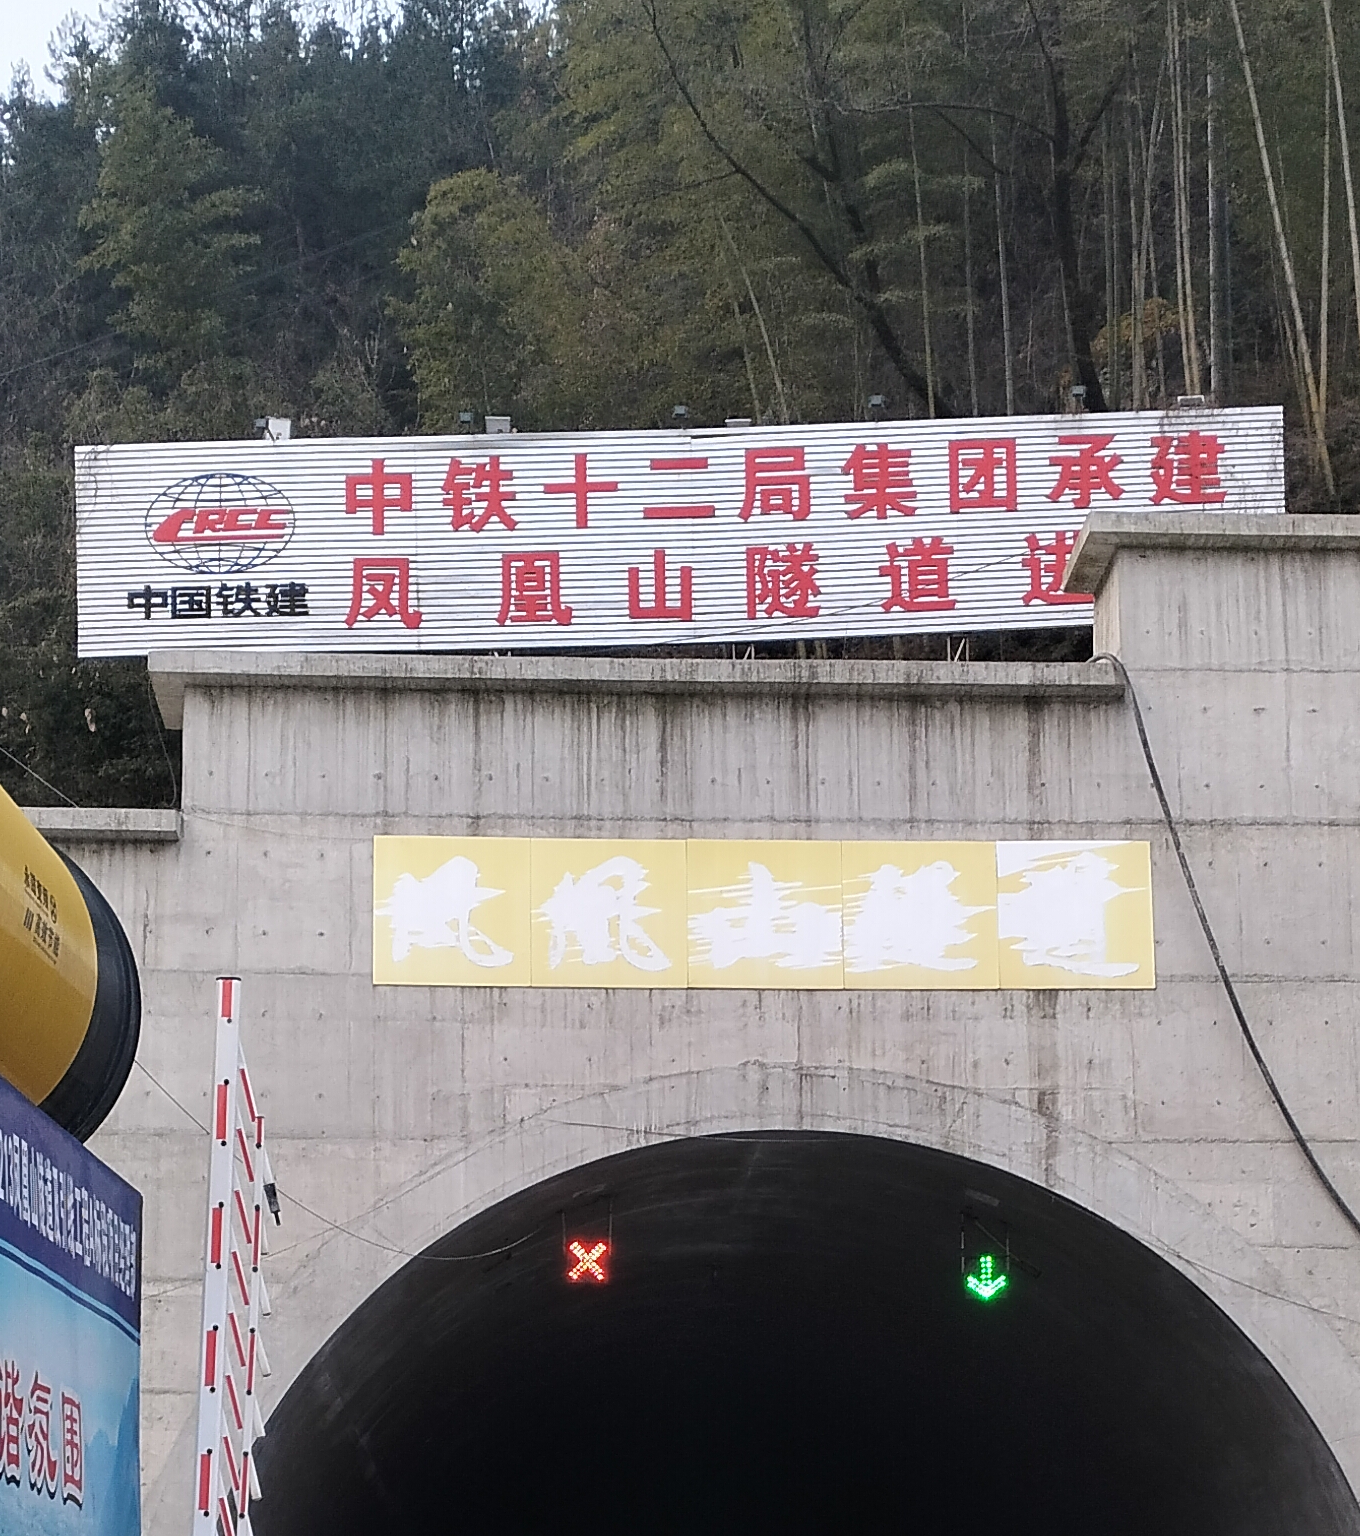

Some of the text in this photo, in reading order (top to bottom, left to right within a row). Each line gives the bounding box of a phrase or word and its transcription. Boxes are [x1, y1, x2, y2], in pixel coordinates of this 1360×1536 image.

[344, 430, 1228, 535] 中铁十二局集团承建
[127, 582, 310, 620] 中国铁建
